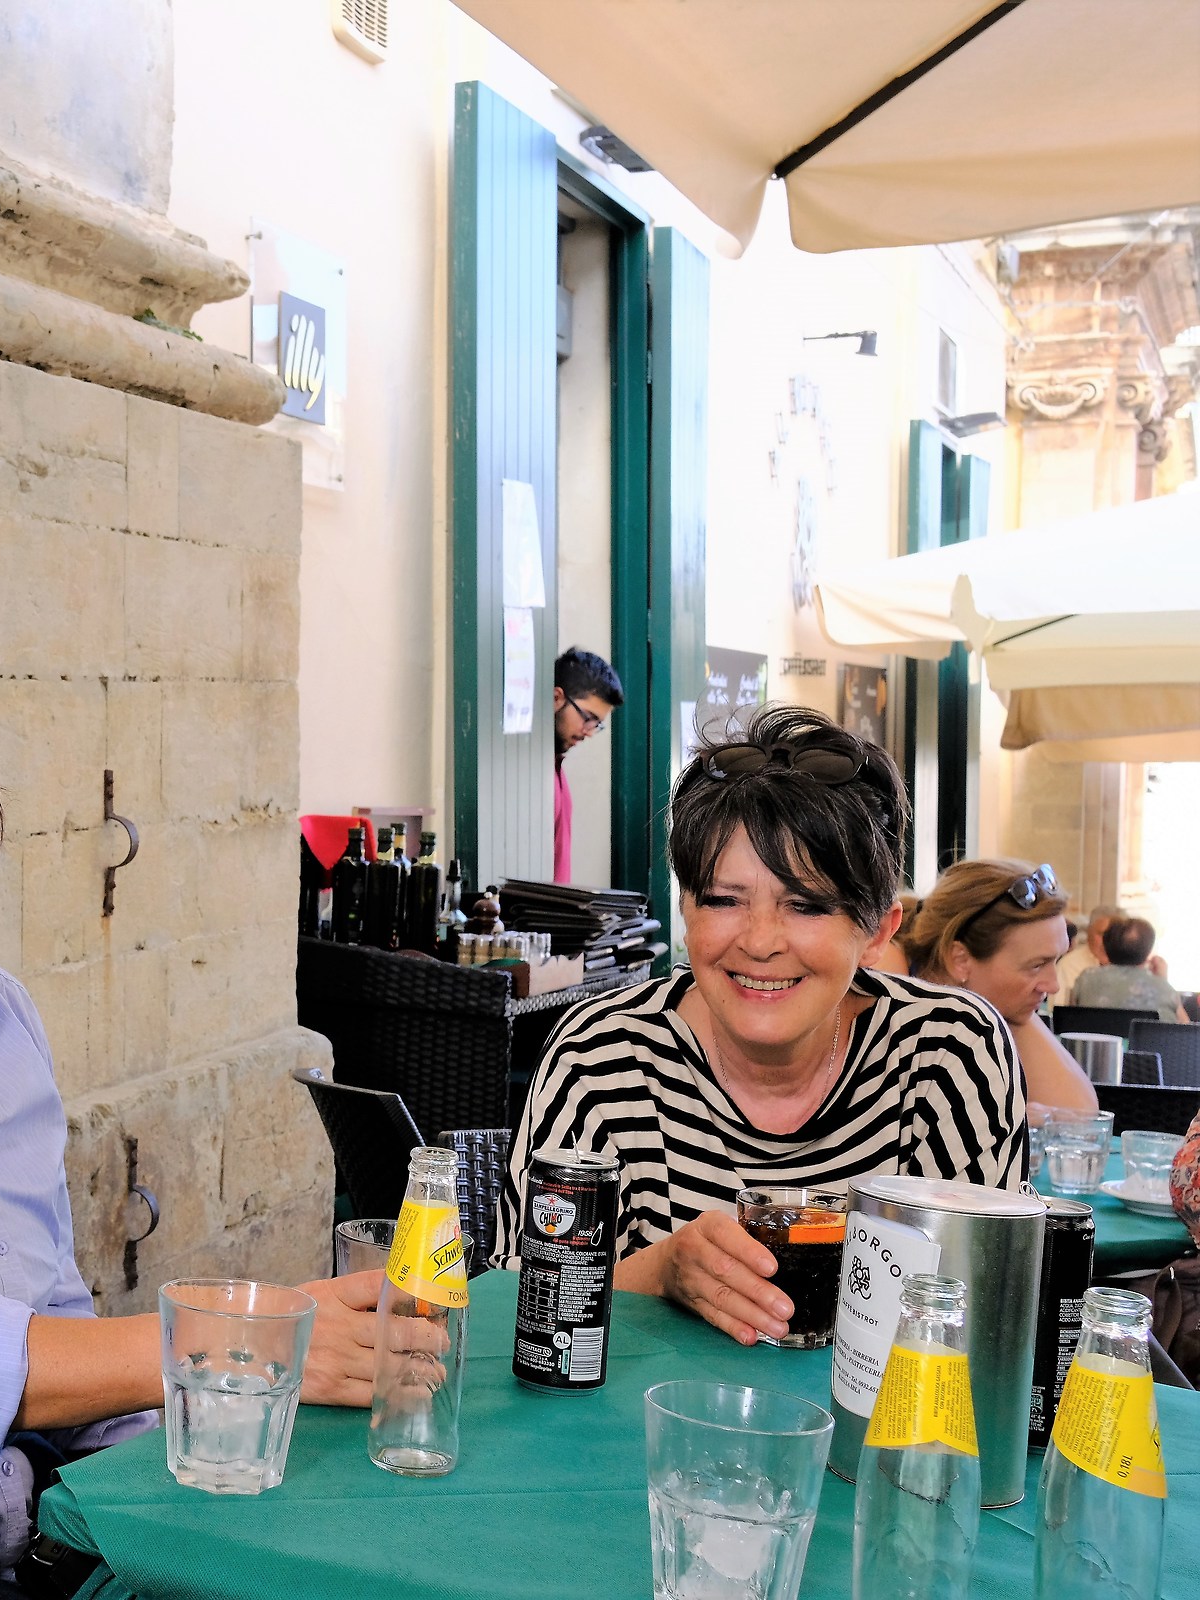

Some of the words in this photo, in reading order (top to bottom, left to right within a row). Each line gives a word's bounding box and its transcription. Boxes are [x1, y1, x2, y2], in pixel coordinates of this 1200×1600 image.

[285, 314, 325, 411] illy
[434, 1242, 461, 1273] Schwe
[397, 1264, 411, 1282] 0,18L
[555, 1335, 569, 1344] AL
[851, 1347, 880, 1368] BIRRERIA
[1053, 1403, 1058, 1413] 3
[1117, 1455, 1133, 1478] 0,18L
